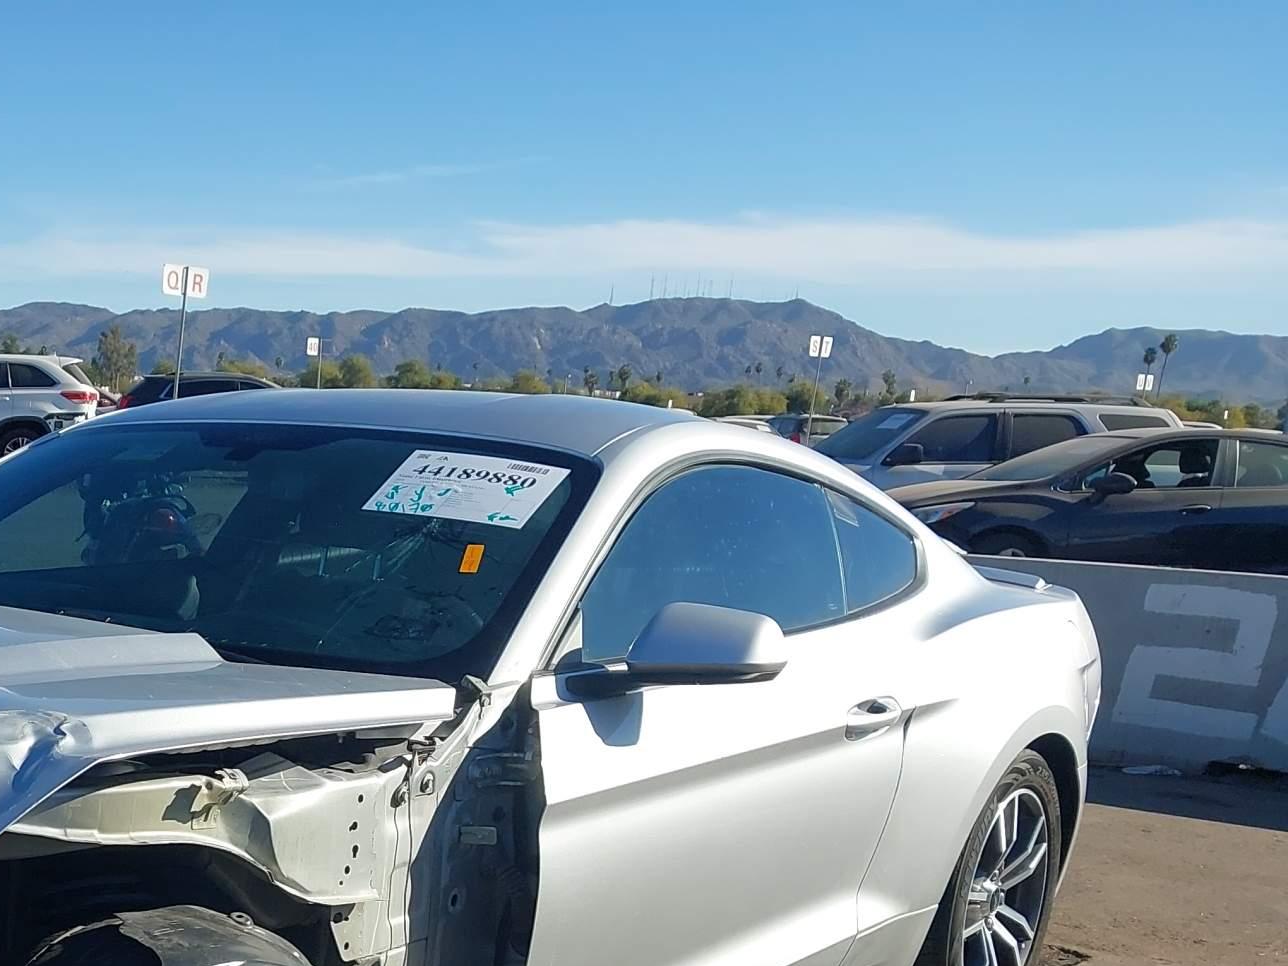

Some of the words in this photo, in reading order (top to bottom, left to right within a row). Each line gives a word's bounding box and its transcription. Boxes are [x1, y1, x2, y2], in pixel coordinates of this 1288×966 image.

[167, 270, 179, 290] Q
[192, 273, 204, 293] R
[413, 463, 537, 489] 44189880
[1112, 583, 1288, 746] 2
